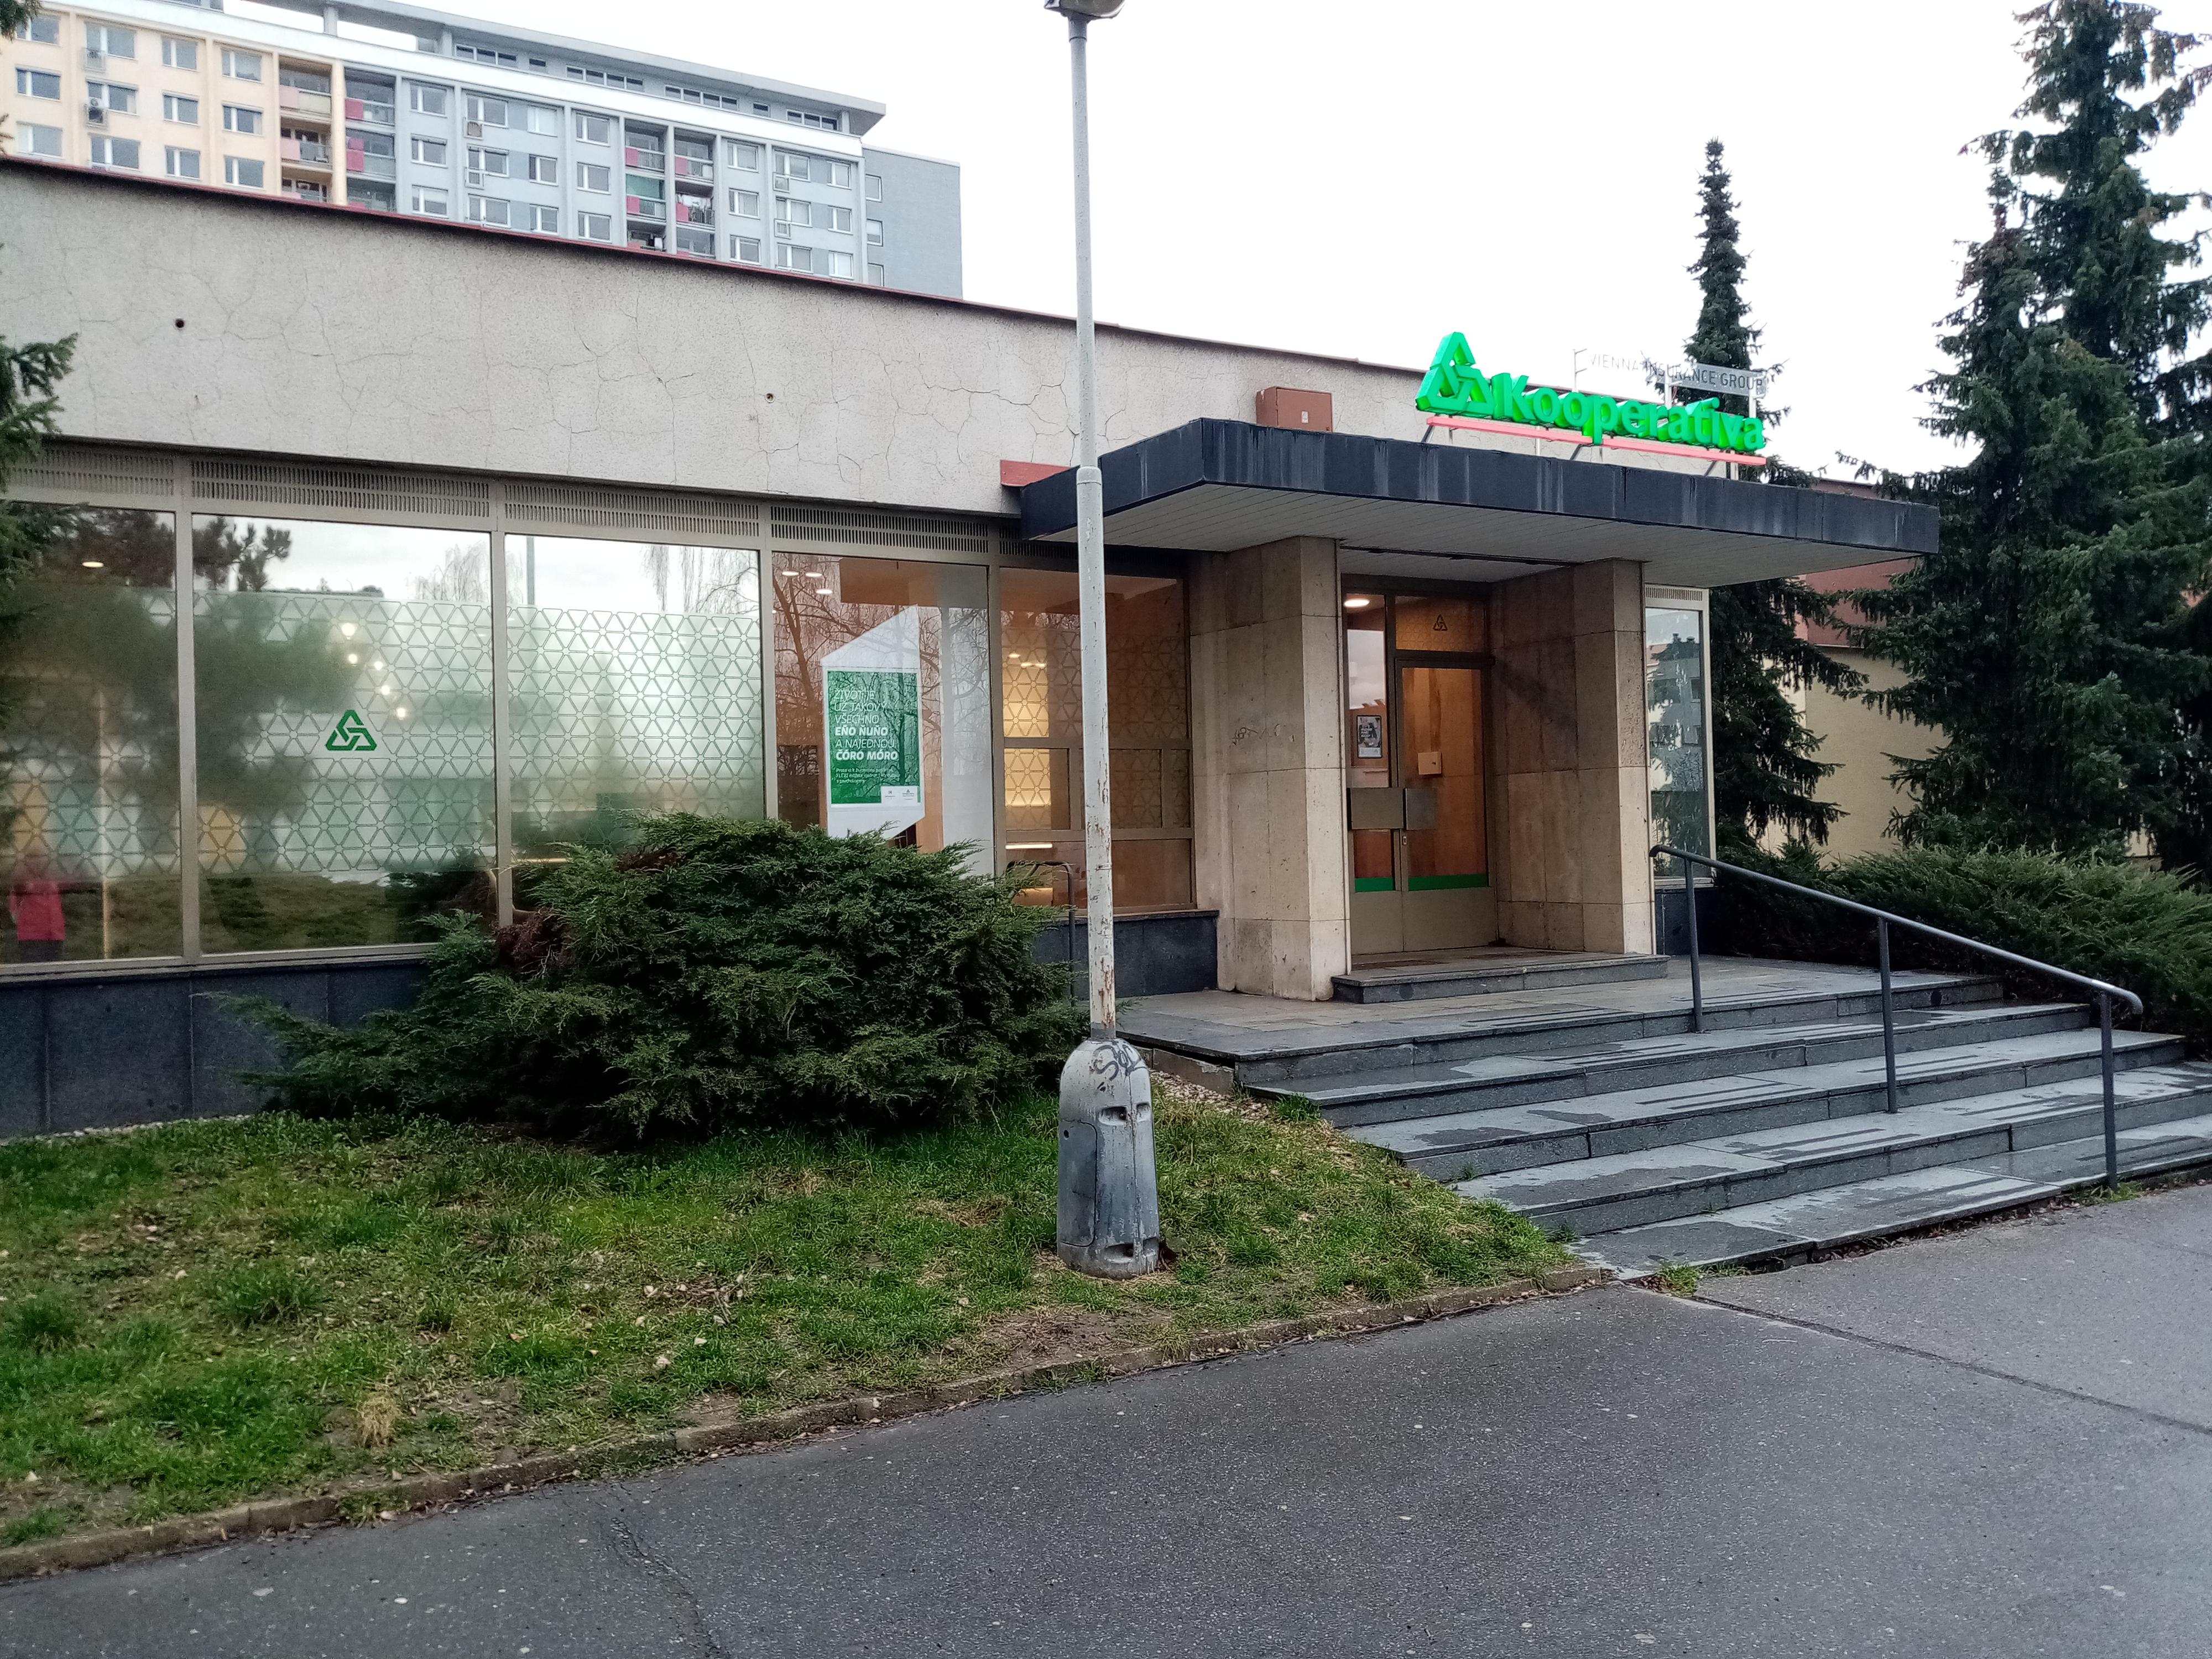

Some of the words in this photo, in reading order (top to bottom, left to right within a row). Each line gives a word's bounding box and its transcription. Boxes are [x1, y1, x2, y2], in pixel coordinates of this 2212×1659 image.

[1645, 361, 1716, 385] INSURANCE
[1720, 372, 1762, 391] GROUP
[1491, 372, 1766, 451] Kooperativa
[834, 687, 863, 700] ŽIVOT
[835, 712, 879, 724] VŠECHNO
[835, 739, 842, 748] A
[845, 739, 895, 750] NAJEDNOU
[836, 749, 864, 760] ČÓRO
[867, 749, 898, 760] MÓRO
